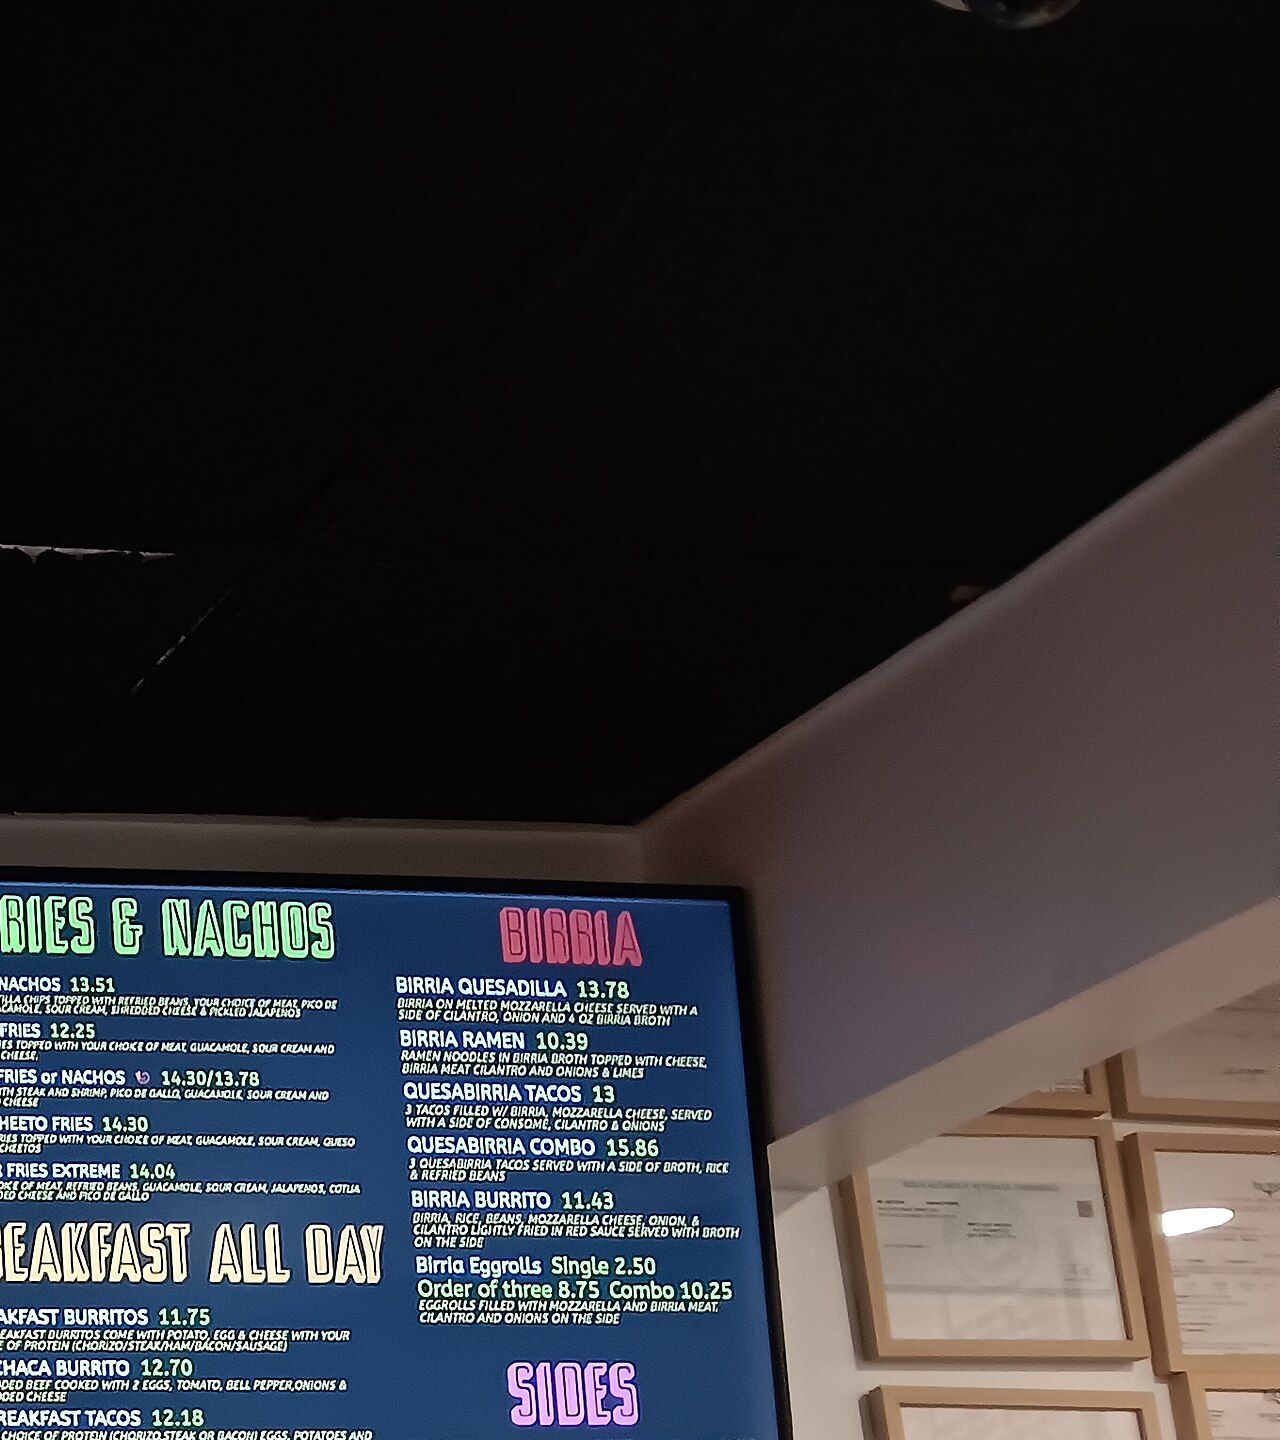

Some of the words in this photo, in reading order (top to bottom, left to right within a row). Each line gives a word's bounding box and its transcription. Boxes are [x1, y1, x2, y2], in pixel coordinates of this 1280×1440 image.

[112, 898, 143, 954] &
[162, 899, 334, 958] NACHOS
[500, 907, 642, 966] BIRRIA
[70, 977, 115, 992] 13.51
[396, 977, 454, 994] BIRRIA
[458, 978, 567, 997] QUESADILLA
[577, 981, 629, 998] 13.78
[209, 1224, 290, 1283] ALL
[306, 1225, 383, 1284] DAY
[416, 1256, 464, 1274] Birria
[470, 1256, 542, 1278] Eggrolls
[551, 1256, 609, 1279] Single
[615, 1257, 655, 1275] 2.50
[64, 1309, 148, 1325] BURRITOS
[159, 1308, 210, 1325] 11.75
[508, 1363, 638, 1425] SIDES
